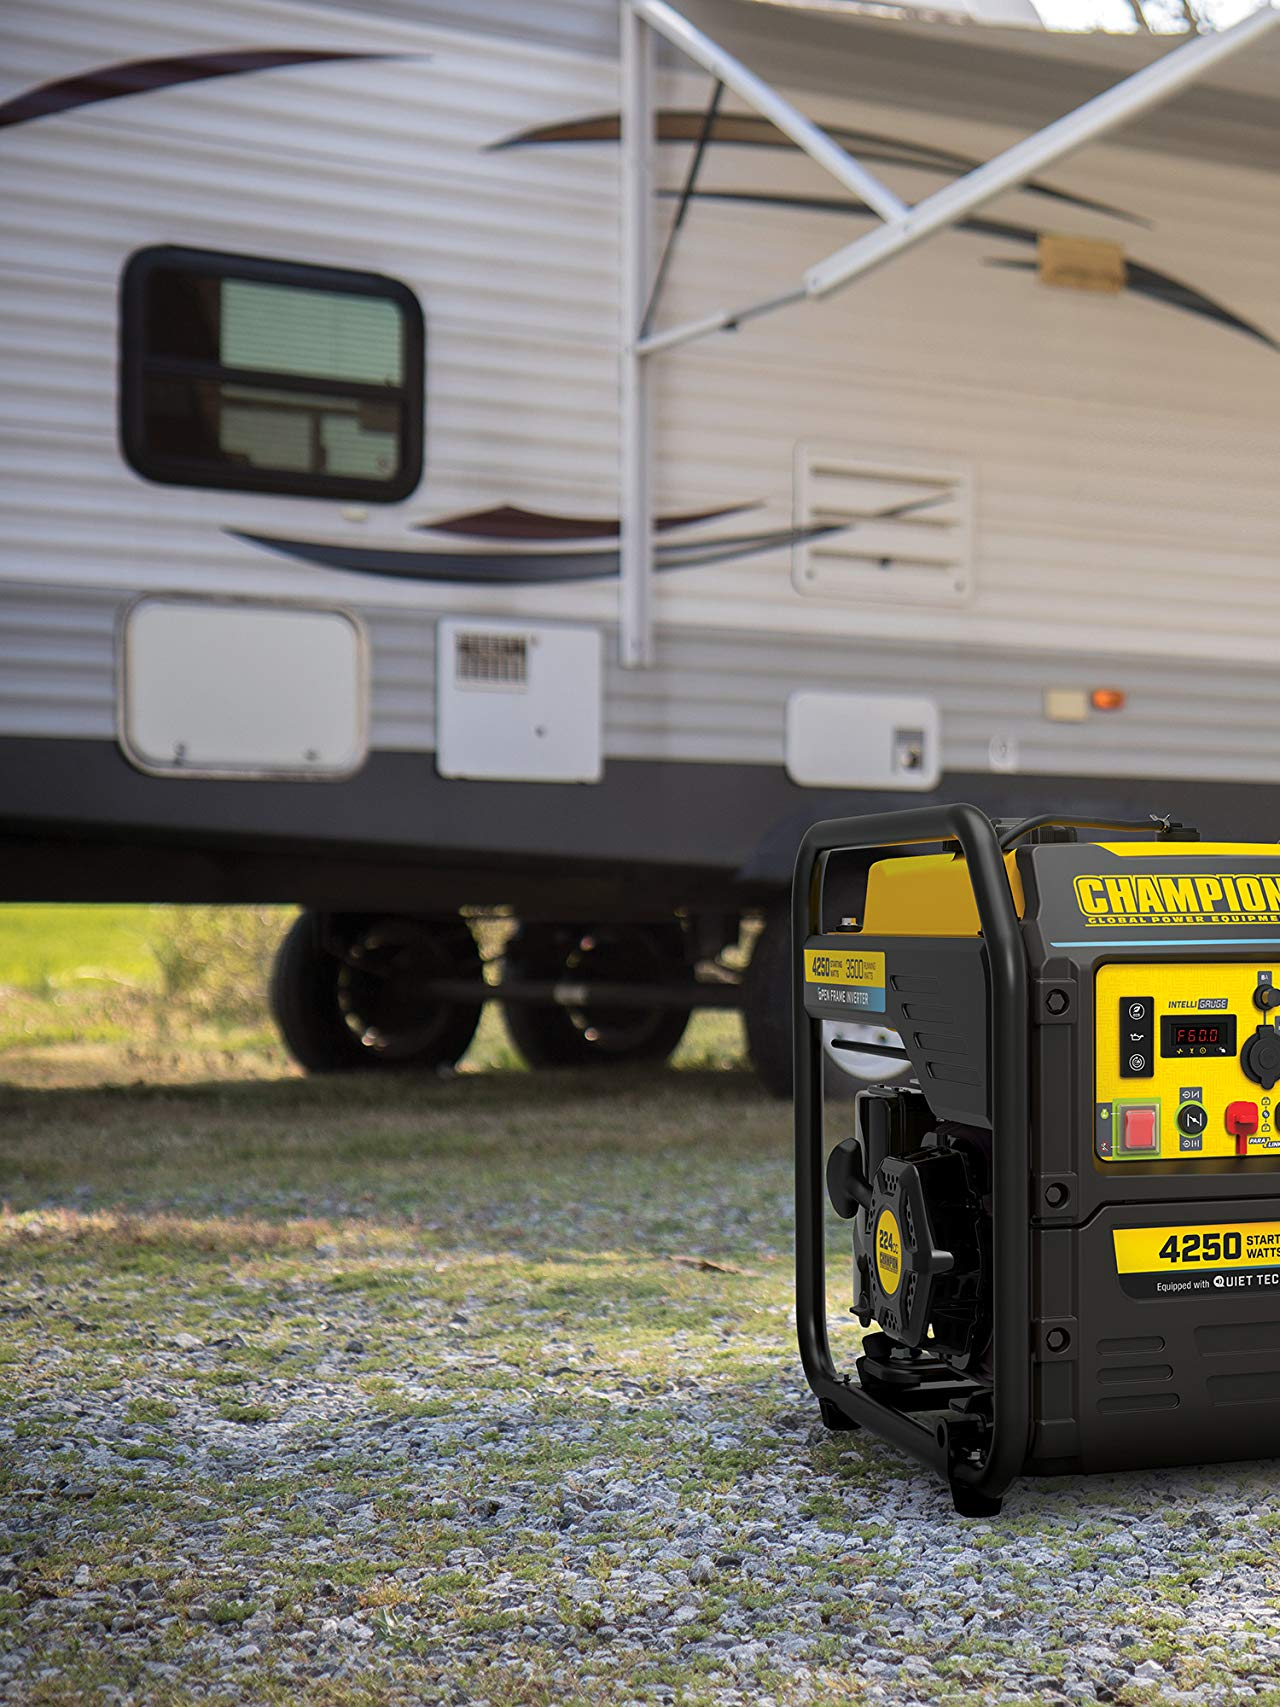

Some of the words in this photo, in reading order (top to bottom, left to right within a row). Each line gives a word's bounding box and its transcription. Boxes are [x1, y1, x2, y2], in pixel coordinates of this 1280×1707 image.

[1087, 916, 1147, 925] GLOBAL
[1151, 916, 1205, 924] POWER
[812, 957, 830, 977] 4250
[846, 958, 864, 980] 3500
[830, 989, 846, 1003] FRAME
[846, 991, 869, 1005] INVERTER
[1158, 1232, 1242, 1263] 4250
[1156, 1281, 1192, 1292] Equipped
[1193, 1280, 1210, 1289] with
[1213, 1275, 1253, 1288] QUIET
